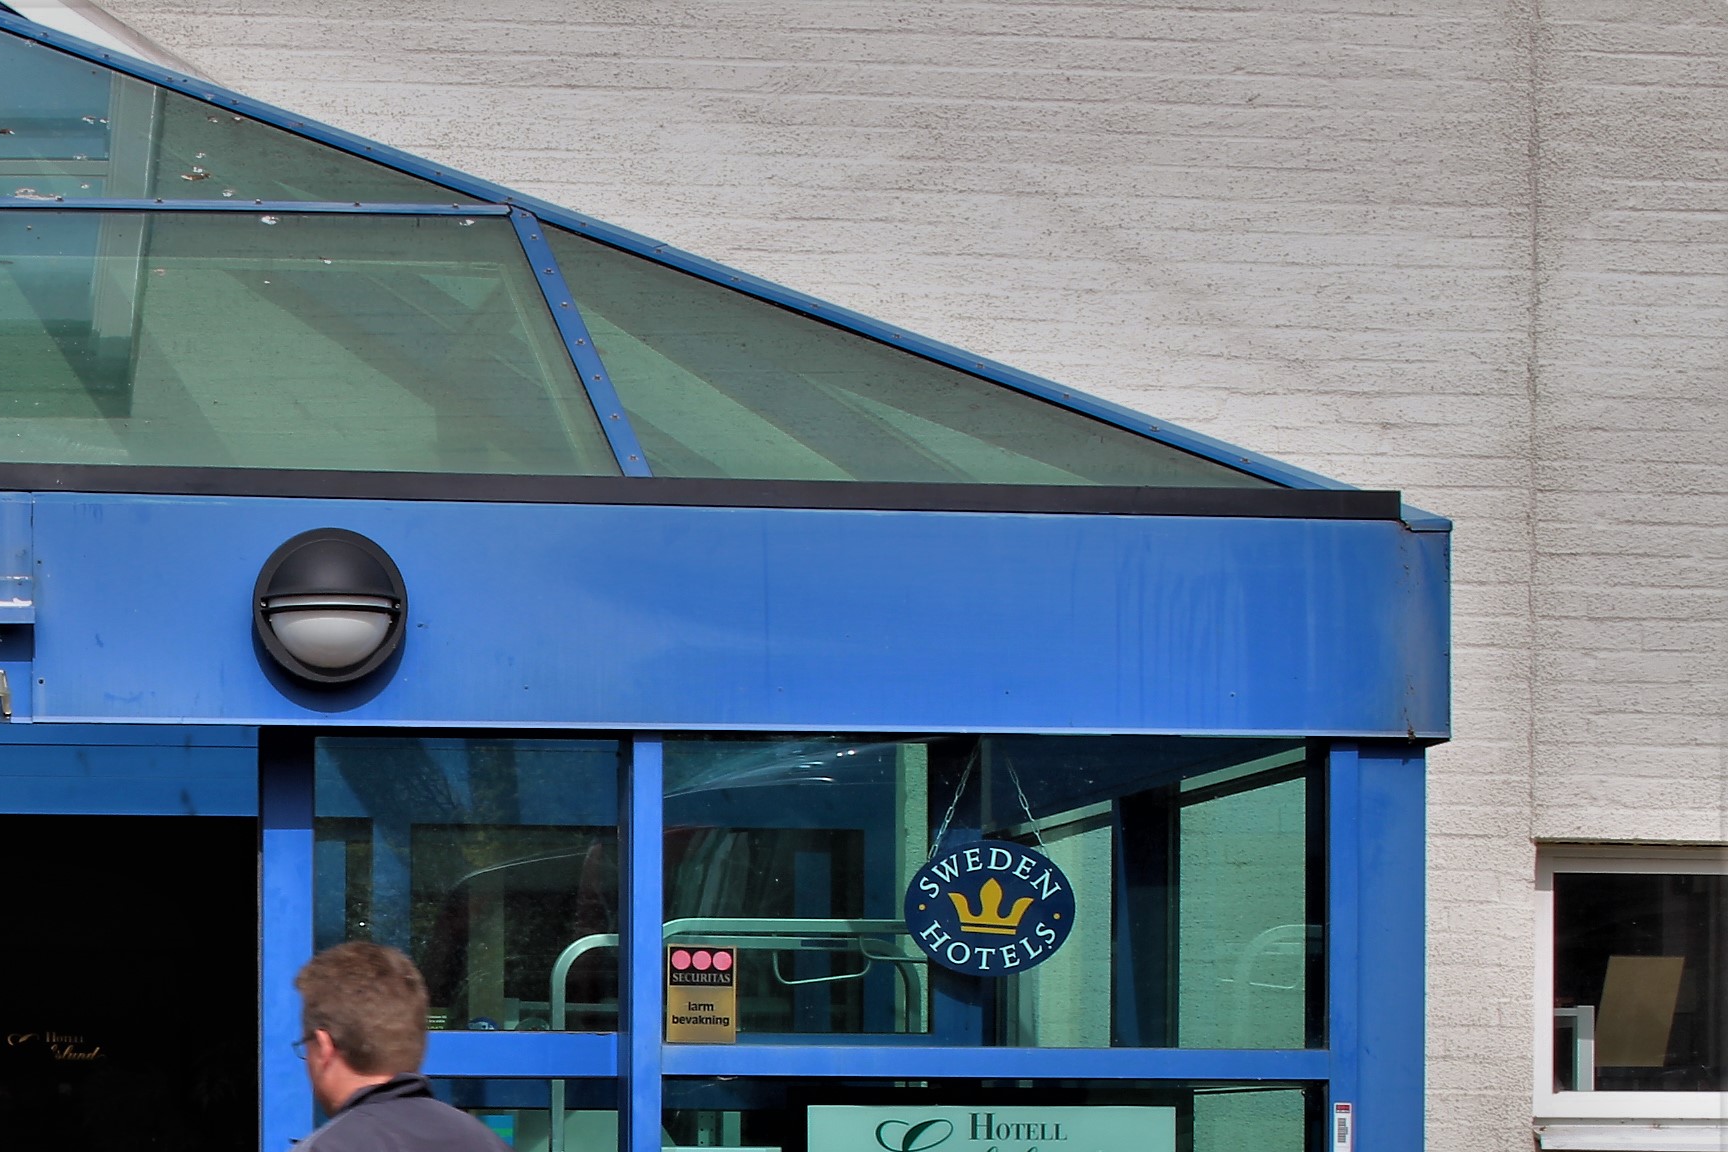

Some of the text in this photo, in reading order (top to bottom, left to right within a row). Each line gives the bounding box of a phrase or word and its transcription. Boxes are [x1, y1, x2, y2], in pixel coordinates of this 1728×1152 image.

[919, 847, 1062, 901] SWEDEN
[919, 919, 1056, 970] HOTELS
[672, 972, 731, 983] SECURITAS
[688, 1001, 714, 1012] larm
[672, 1014, 730, 1027] bevakning
[968, 1112, 1068, 1141] HOTELL
